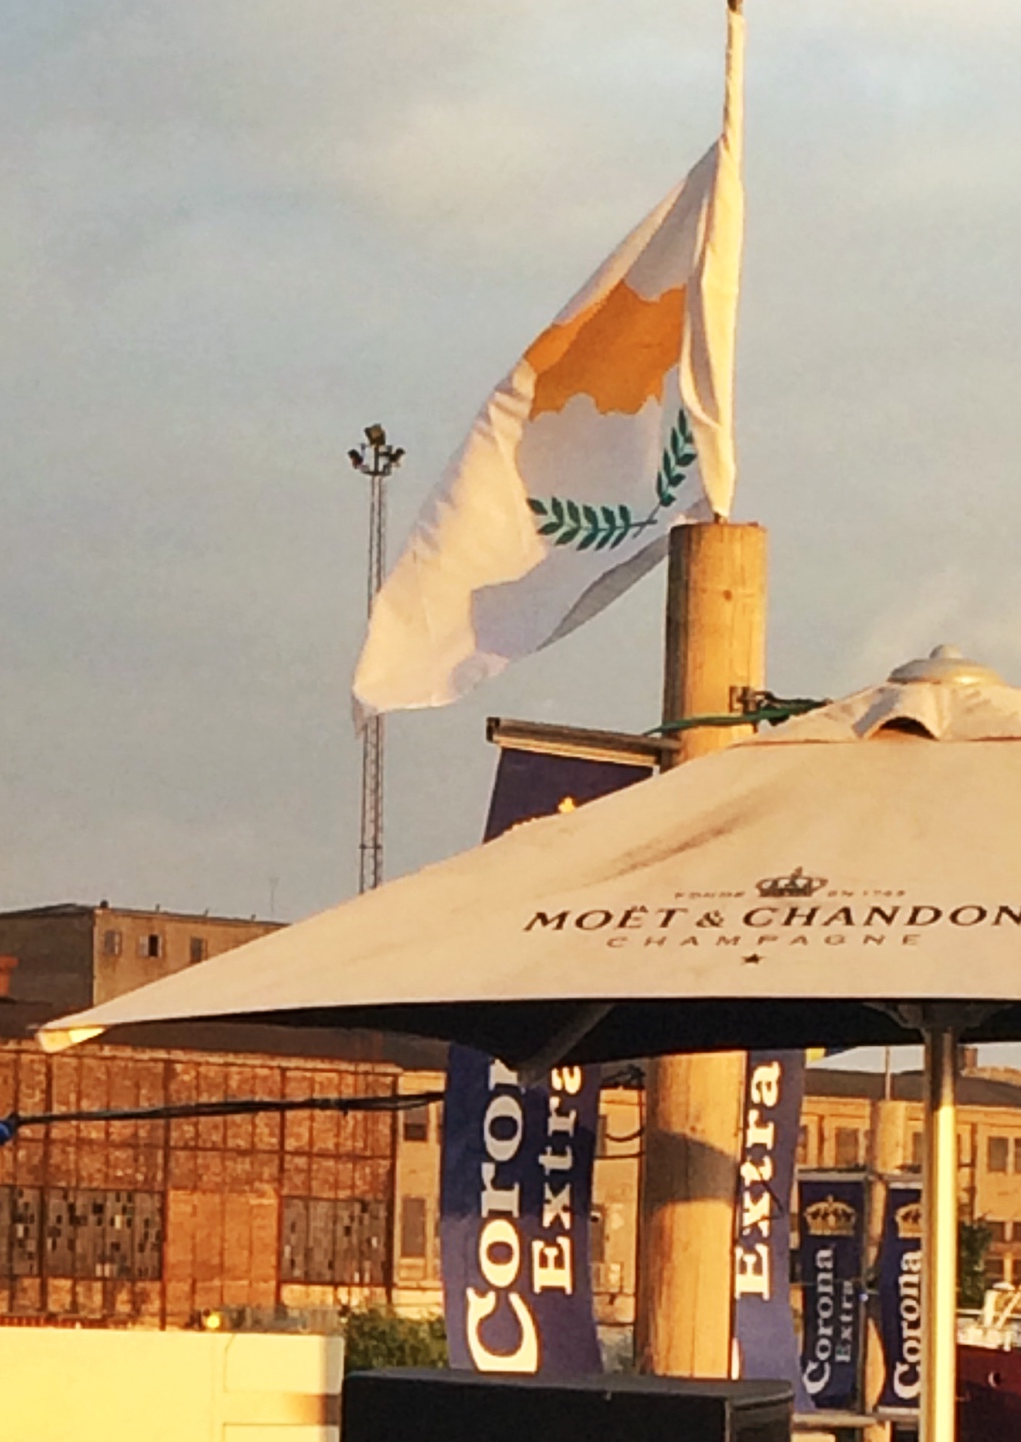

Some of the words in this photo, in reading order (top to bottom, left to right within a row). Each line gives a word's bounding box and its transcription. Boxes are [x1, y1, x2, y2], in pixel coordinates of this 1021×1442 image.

[523, 906, 689, 931] MOËT
[695, 910, 724, 928] &
[742, 904, 1021, 928] CHANDON
[606, 934, 921, 948] CHAMPAGNE
[803, 1247, 834, 1394] Corona
[835, 1280, 854, 1363] Extra
[893, 1250, 922, 1399] Corona
